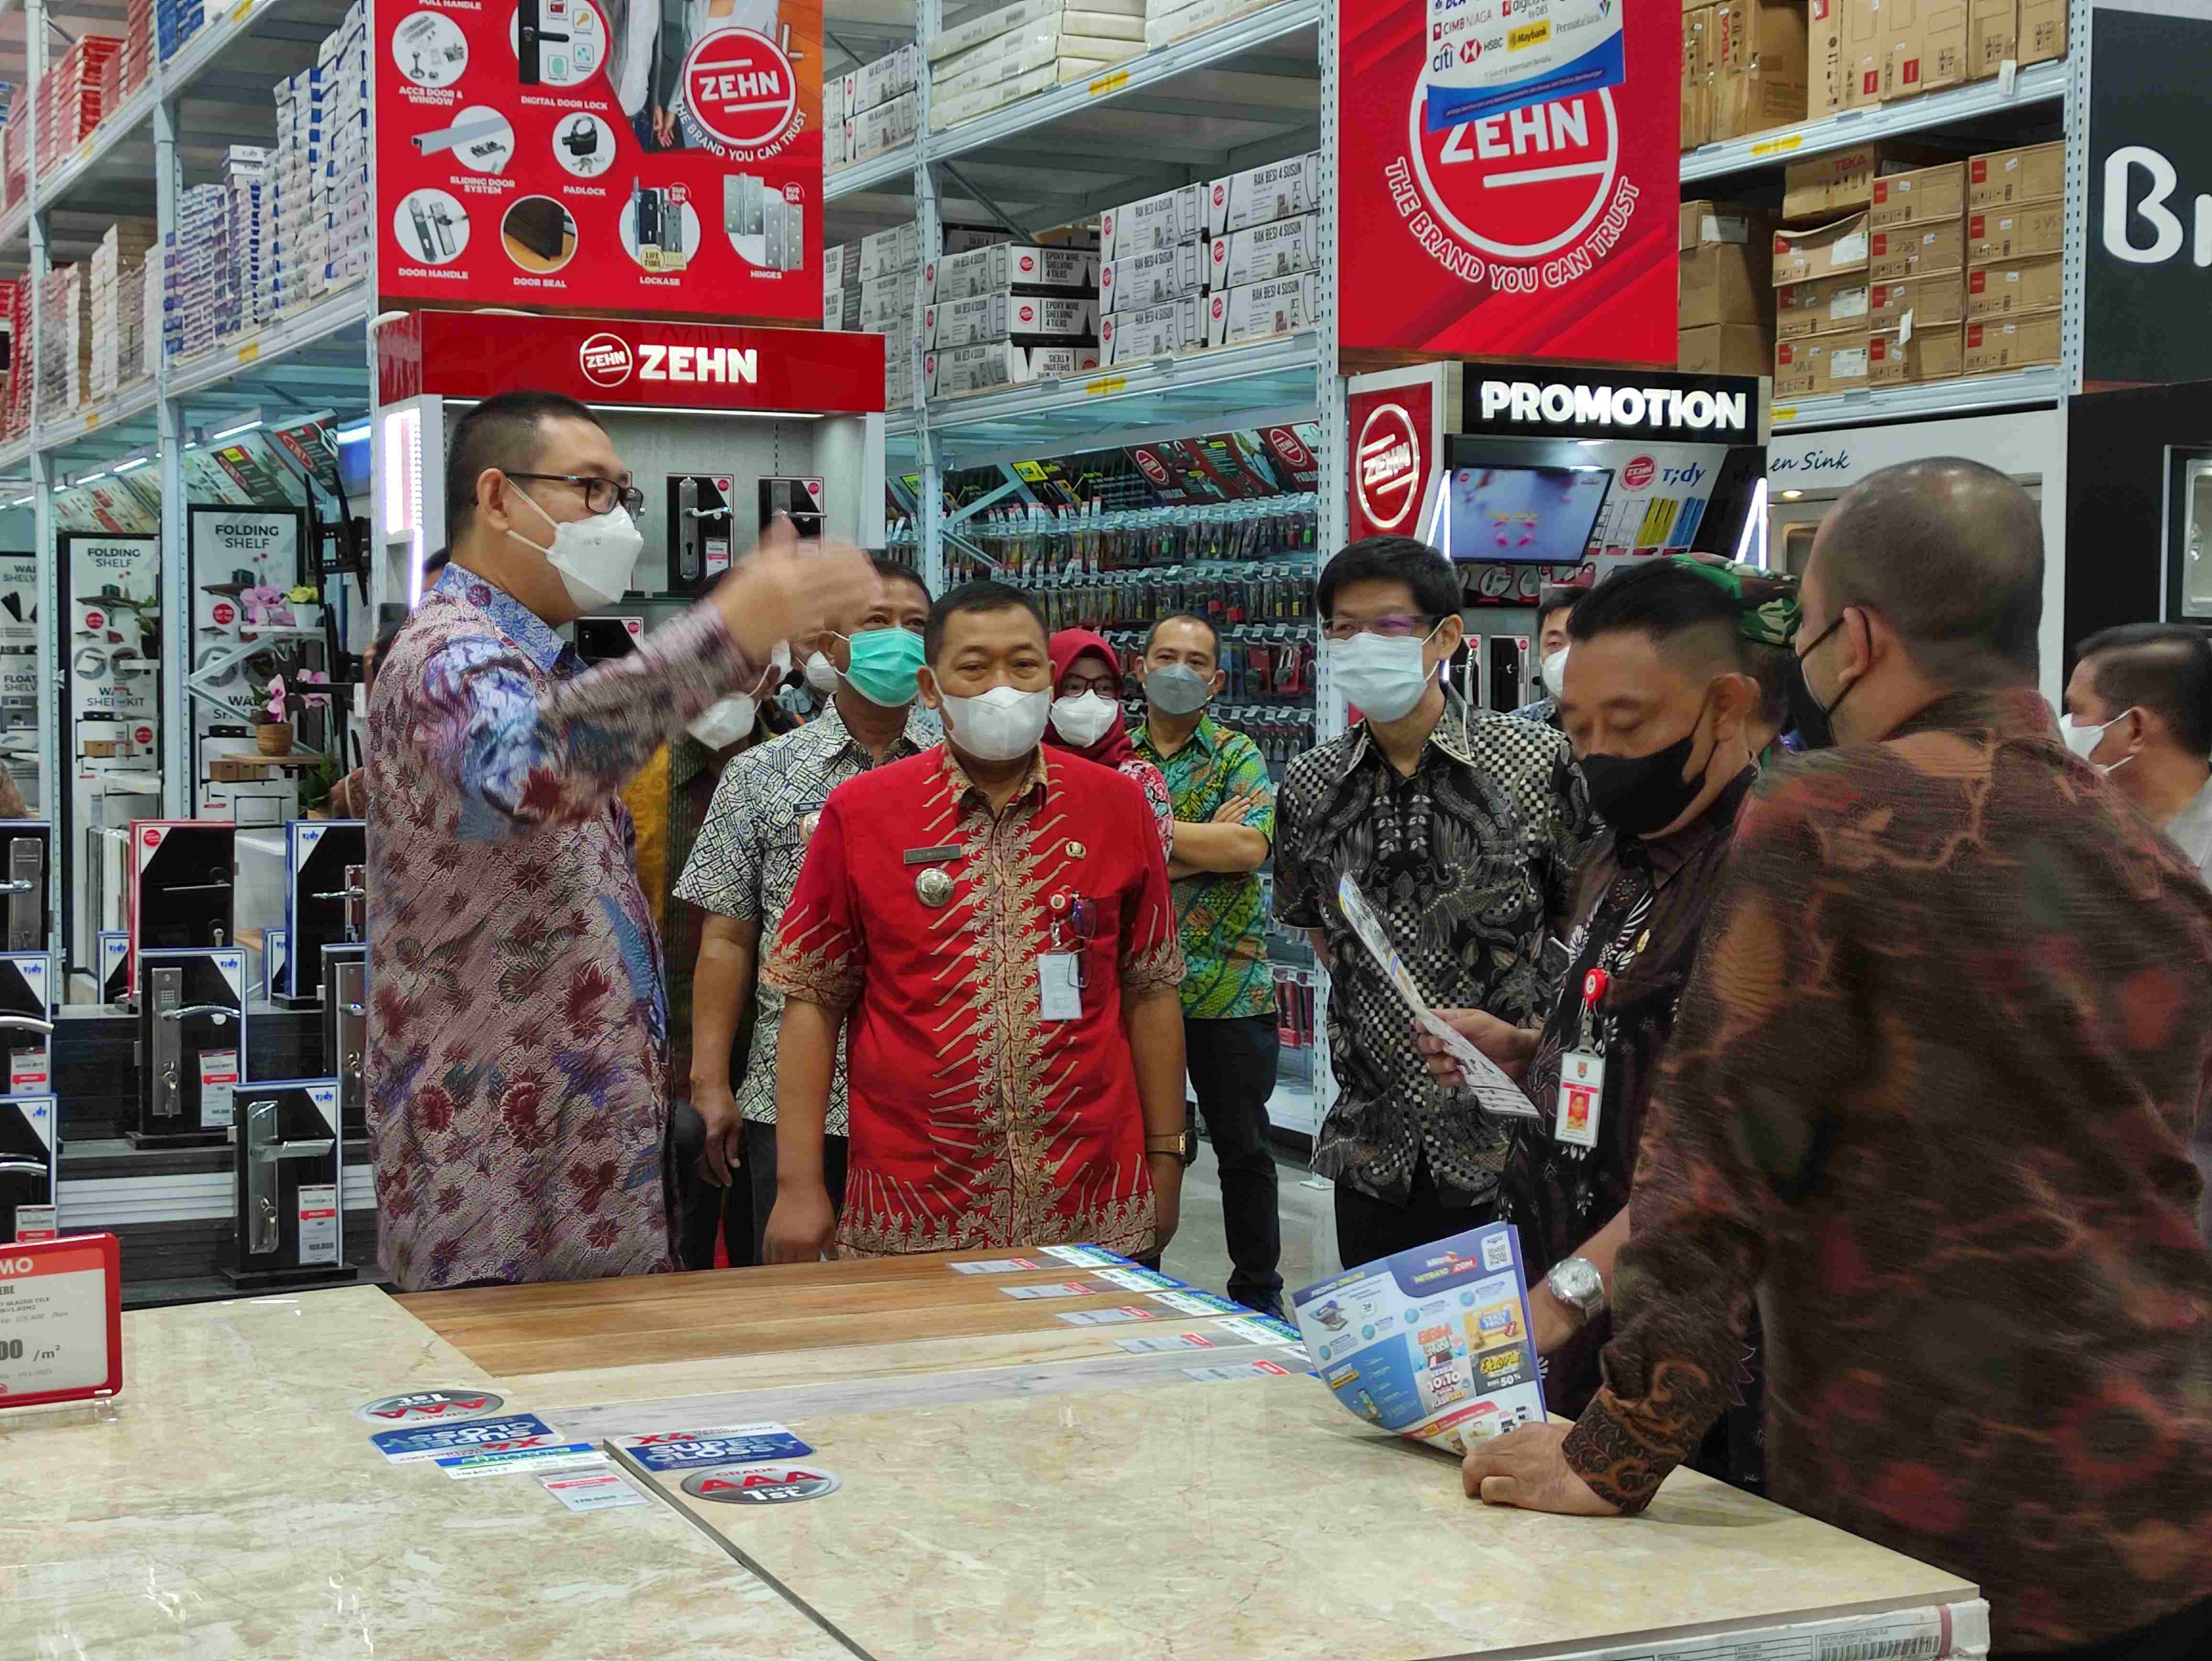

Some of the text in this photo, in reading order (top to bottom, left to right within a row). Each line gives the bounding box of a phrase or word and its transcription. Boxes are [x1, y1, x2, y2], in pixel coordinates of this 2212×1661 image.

[1517, 26, 1547, 44] Maybank
[1484, 37, 1503, 52] HSBC
[1433, 46, 1453, 72] citi
[699, 70, 780, 101] ZEHN
[409, 96, 454, 106] WINDOW
[521, 96, 608, 110] DIGITAL DOOR LOCK
[675, 100, 807, 162] THE BRAND YOU CAN TRUST
[1440, 99, 1589, 165] ZEHN
[1835, 153, 1868, 170] TEKA
[1254, 161, 1302, 187] RAK BESI 4 SUSUN
[450, 176, 515, 188] SLIDING DOOR
[464, 185, 502, 195] SYSTEM
[563, 186, 606, 196] PADLOCK
[1385, 157, 1641, 293] THE BRAND YOU CAN TRUST
[1254, 221, 1302, 244] RAK BESI 4 SUSUN
[1046, 251, 1064, 261] EPOXY
[398, 268, 469, 279] DOOR HANDLE
[750, 270, 782, 279] HINGES
[513, 277, 567, 288] DOOR SEAL
[1252, 279, 1300, 301] RAK BESI 4 SUSUN
[1046, 300, 1064, 310] EPOXY
[585, 344, 758, 383] ZEHN ZEHN
[1481, 380, 1747, 431] PROMOTION
[1363, 441, 1411, 486] ZEHN
[1800, 450, 1851, 471] Sink
[1627, 465, 1653, 477] ZEHN
[215, 524, 279, 536] FOLDING
[225, 538, 271, 549] SHELF
[87, 548, 141, 557] FOLDING
[96, 558, 133, 567] SHELF
[127, 698, 145, 706] KIT
[369, 1396, 487, 1419] AAA
[411, 1411, 470, 1422] GRADE
[647, 1435, 777, 1455] SUPER
[716, 1467, 779, 1477] GRADE
[700, 1470, 829, 1493] AAA
[742, 1488, 805, 1501] 1st
